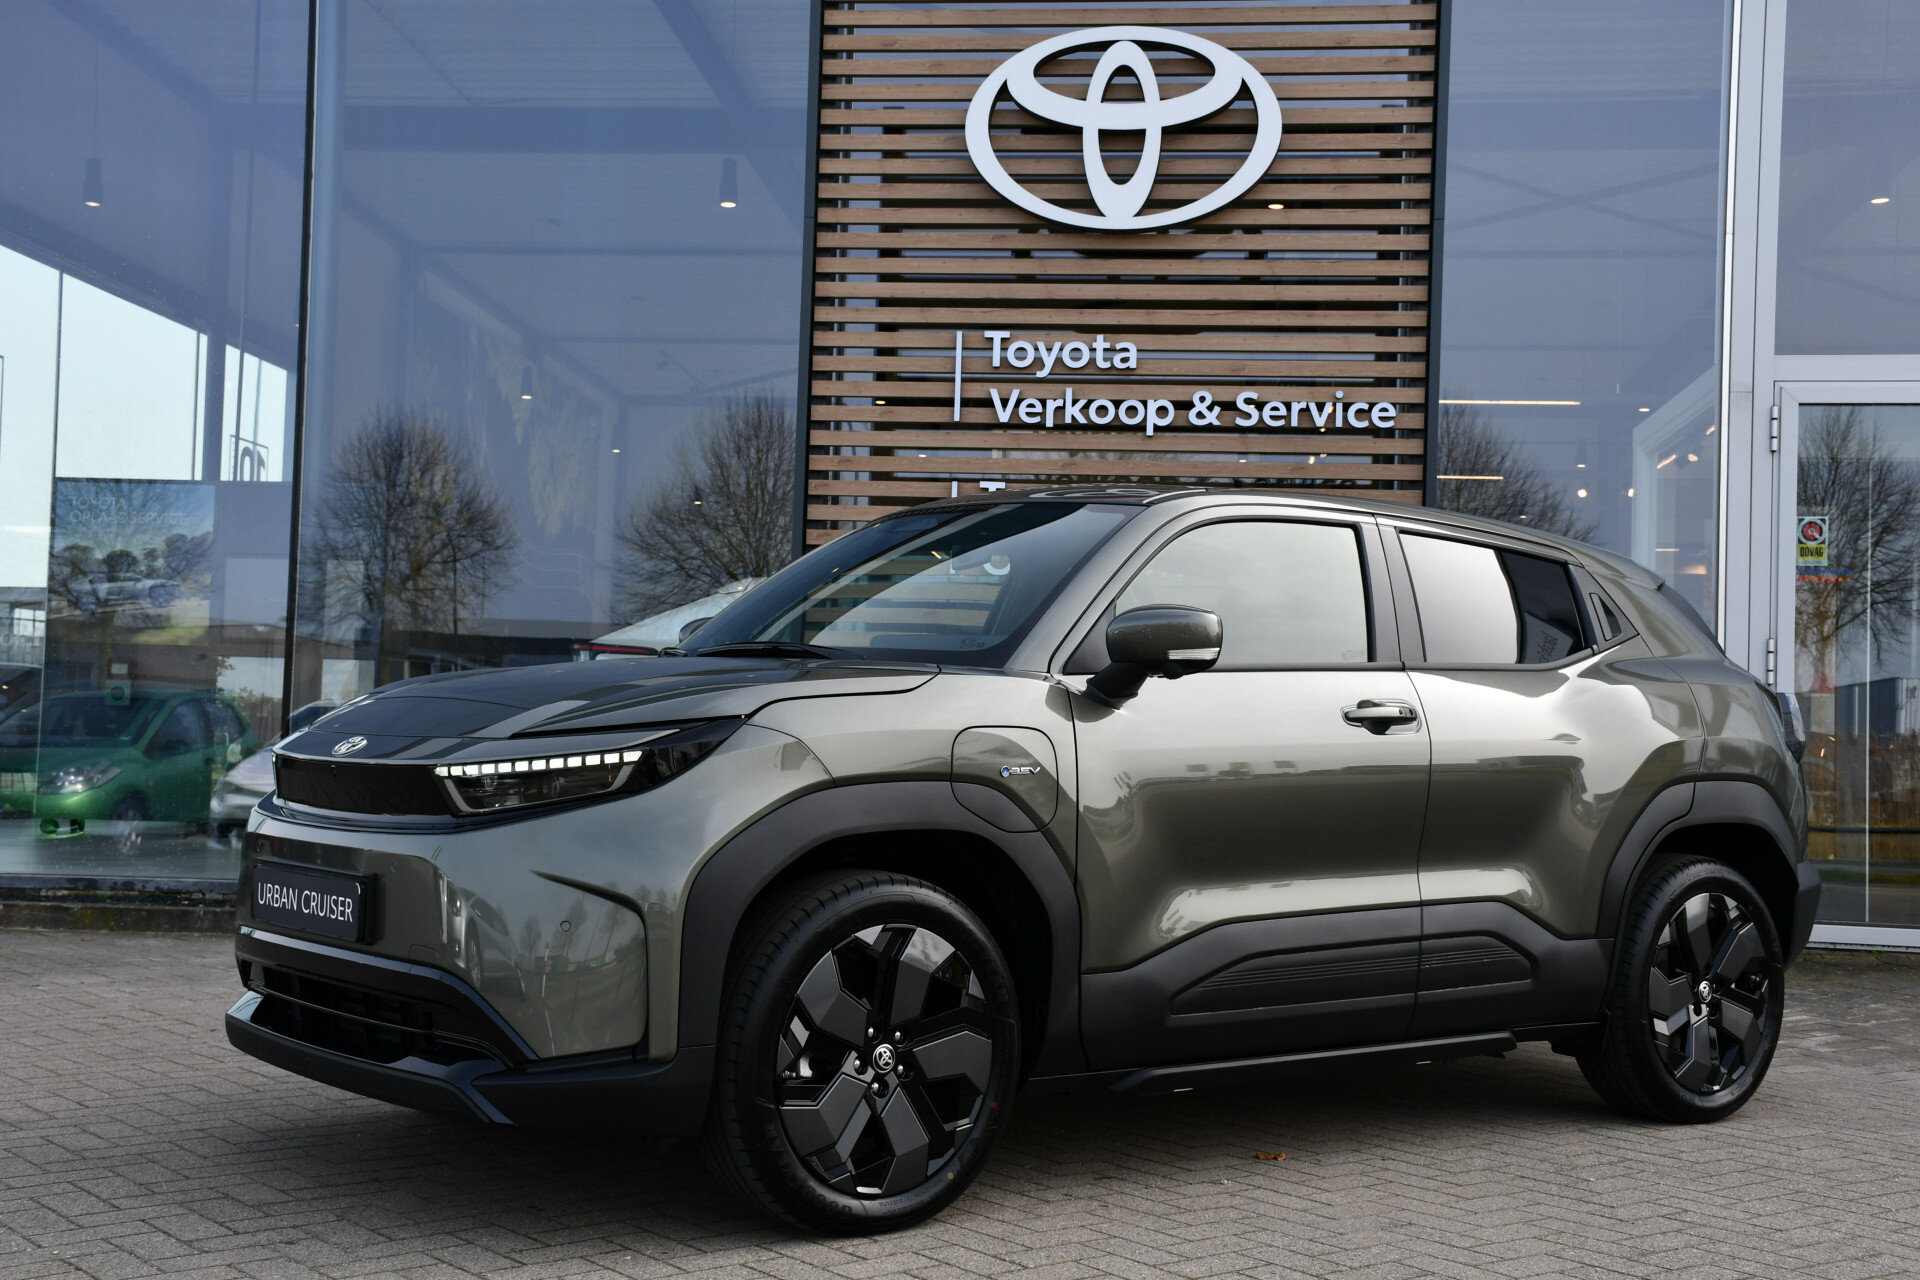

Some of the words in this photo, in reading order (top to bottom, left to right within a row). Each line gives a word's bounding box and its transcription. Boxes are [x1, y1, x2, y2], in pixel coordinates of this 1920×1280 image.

[984, 331, 1138, 378] Toyota
[989, 387, 1175, 436] Verkoop
[1188, 390, 1221, 427] &
[1235, 390, 1397, 429] Service
[69, 496, 126, 509] TOYOTA
[1800, 546, 1824, 558] BOVAG
[257, 881, 298, 911] URBAN
[301, 890, 354, 923] CRUISER
